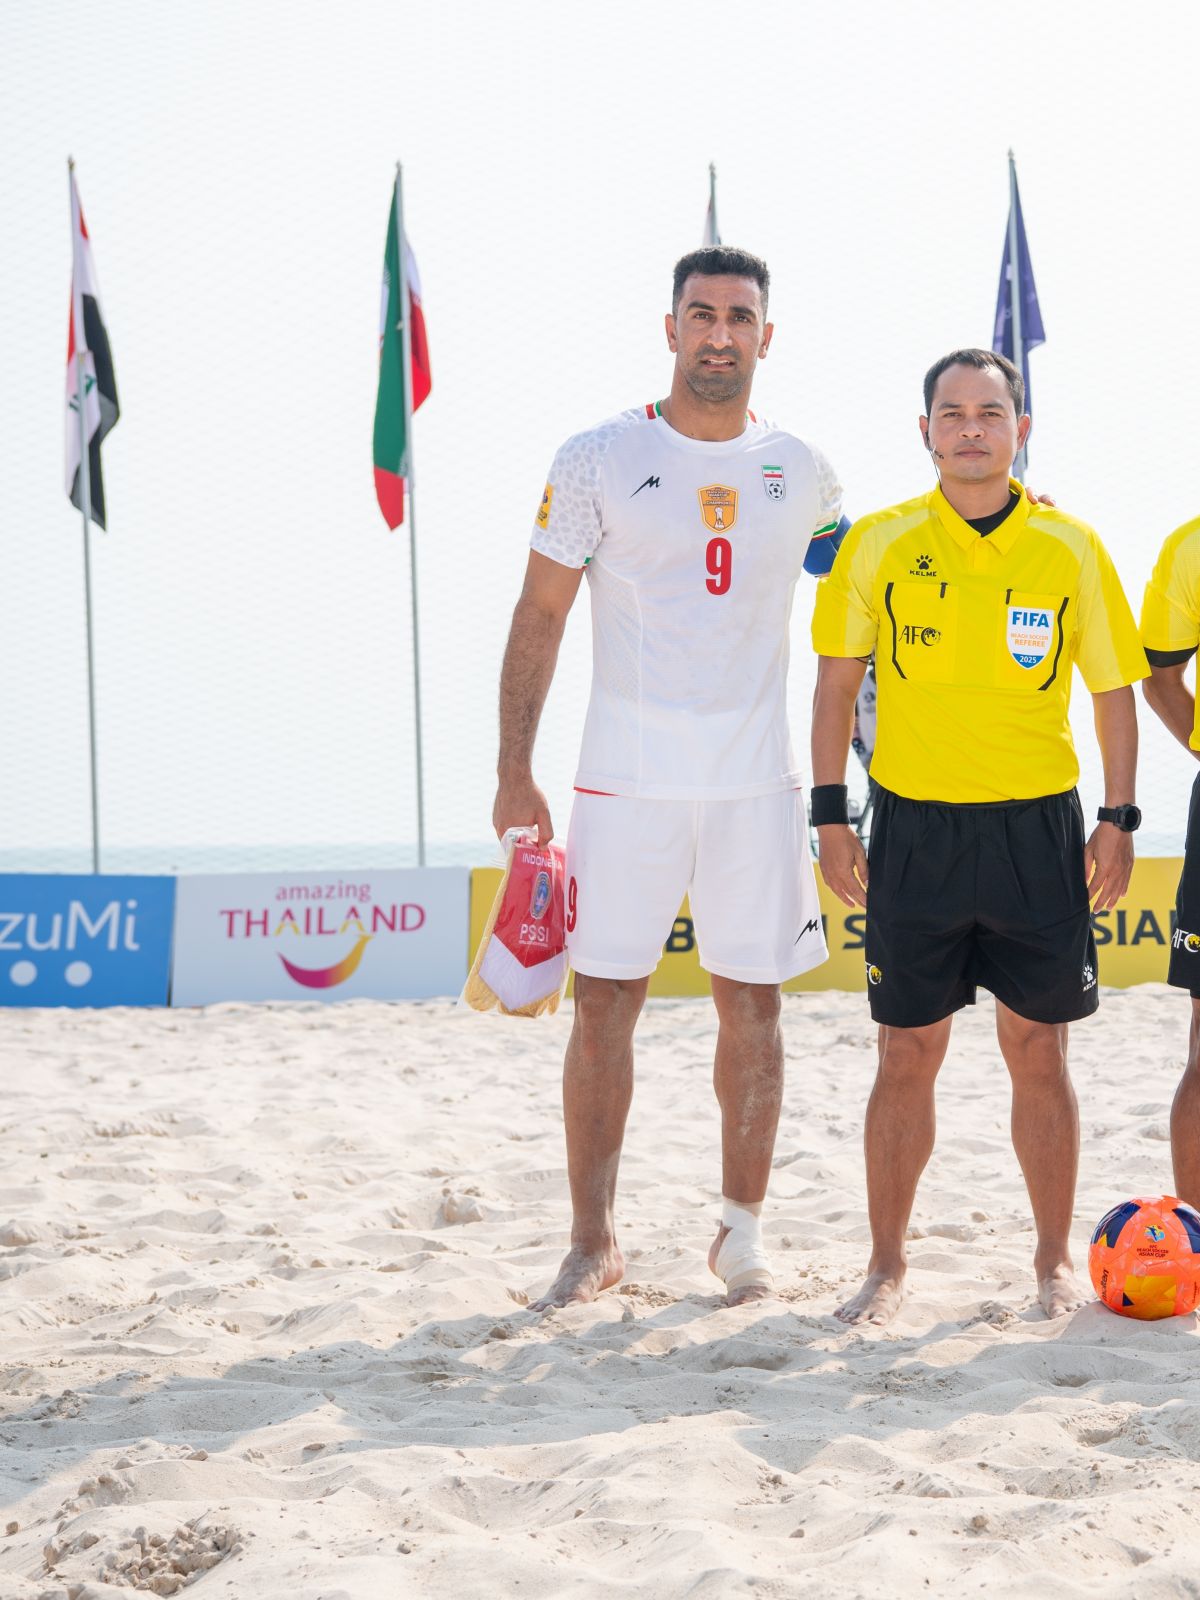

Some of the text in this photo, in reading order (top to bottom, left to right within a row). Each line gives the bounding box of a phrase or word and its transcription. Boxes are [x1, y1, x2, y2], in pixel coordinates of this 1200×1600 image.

[705, 537, 733, 596] 9
[909, 569, 937, 577] KELME
[1012, 611, 1049, 628] FIFA
[898, 625, 941, 647] AFC
[1014, 639, 1046, 648] REFEREE
[1019, 656, 1037, 664] 2025
[275, 880, 372, 903] amazing
[567, 876, 577, 932] 9
[0, 899, 141, 951] zuMi
[219, 902, 426, 939] THAILAND
[520, 923, 549, 942] PSSI
